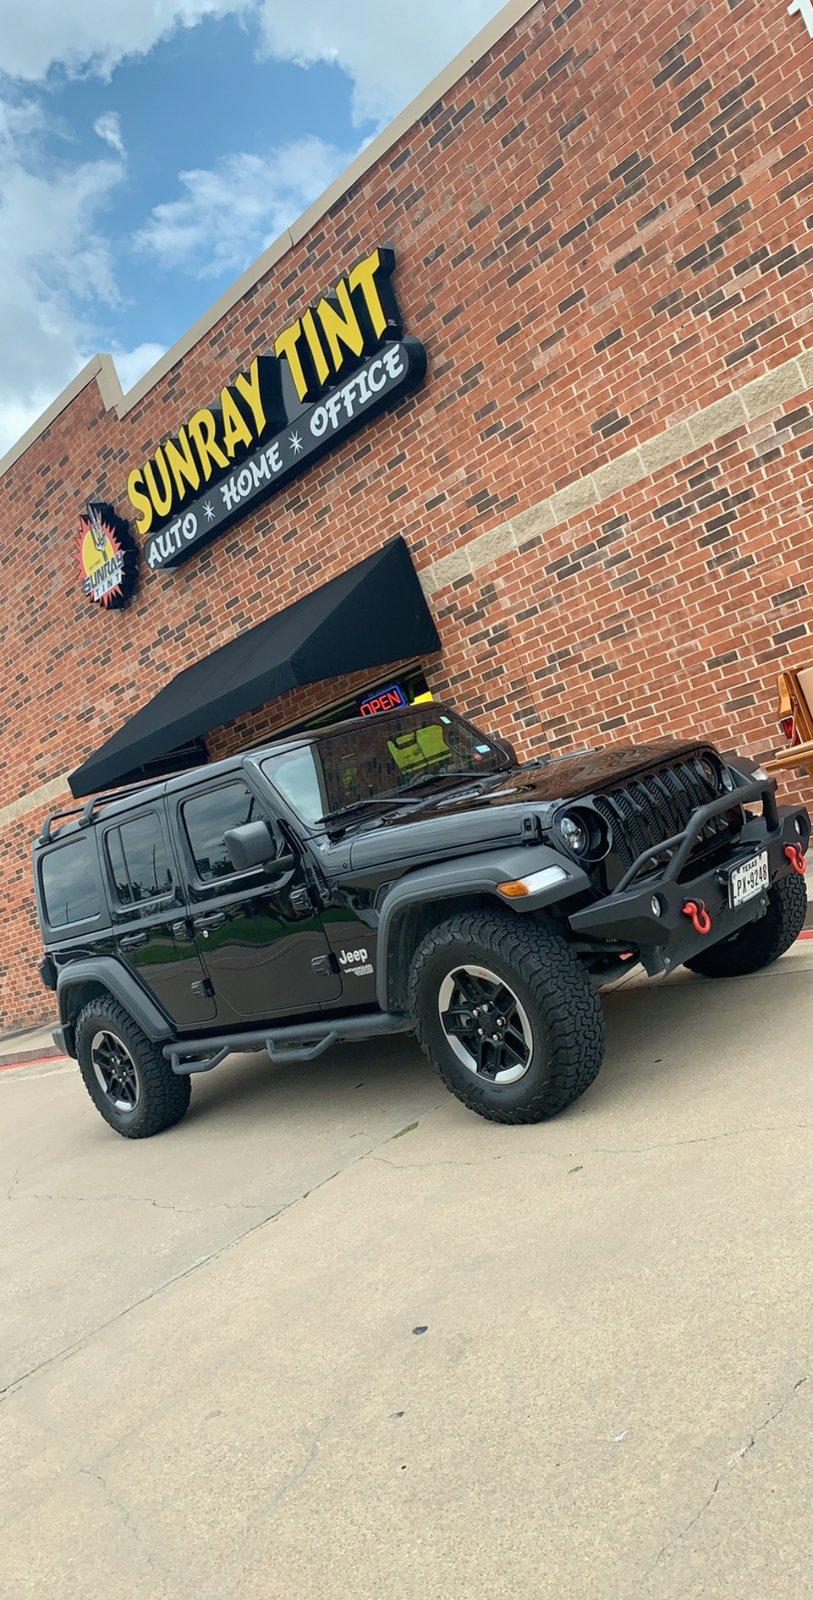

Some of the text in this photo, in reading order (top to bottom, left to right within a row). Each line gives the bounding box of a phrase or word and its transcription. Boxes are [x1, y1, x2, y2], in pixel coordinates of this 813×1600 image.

[127, 247, 388, 535] SUNRAY TINT
[148, 343, 404, 569] AUTO HOME OFFICE
[83, 549, 125, 597] SUNRAY
[95, 572, 121, 597] TINT
[360, 689, 402, 717] OPEN
[742, 859, 758, 873] TEXAS
[338, 948, 368, 965] Jeep
